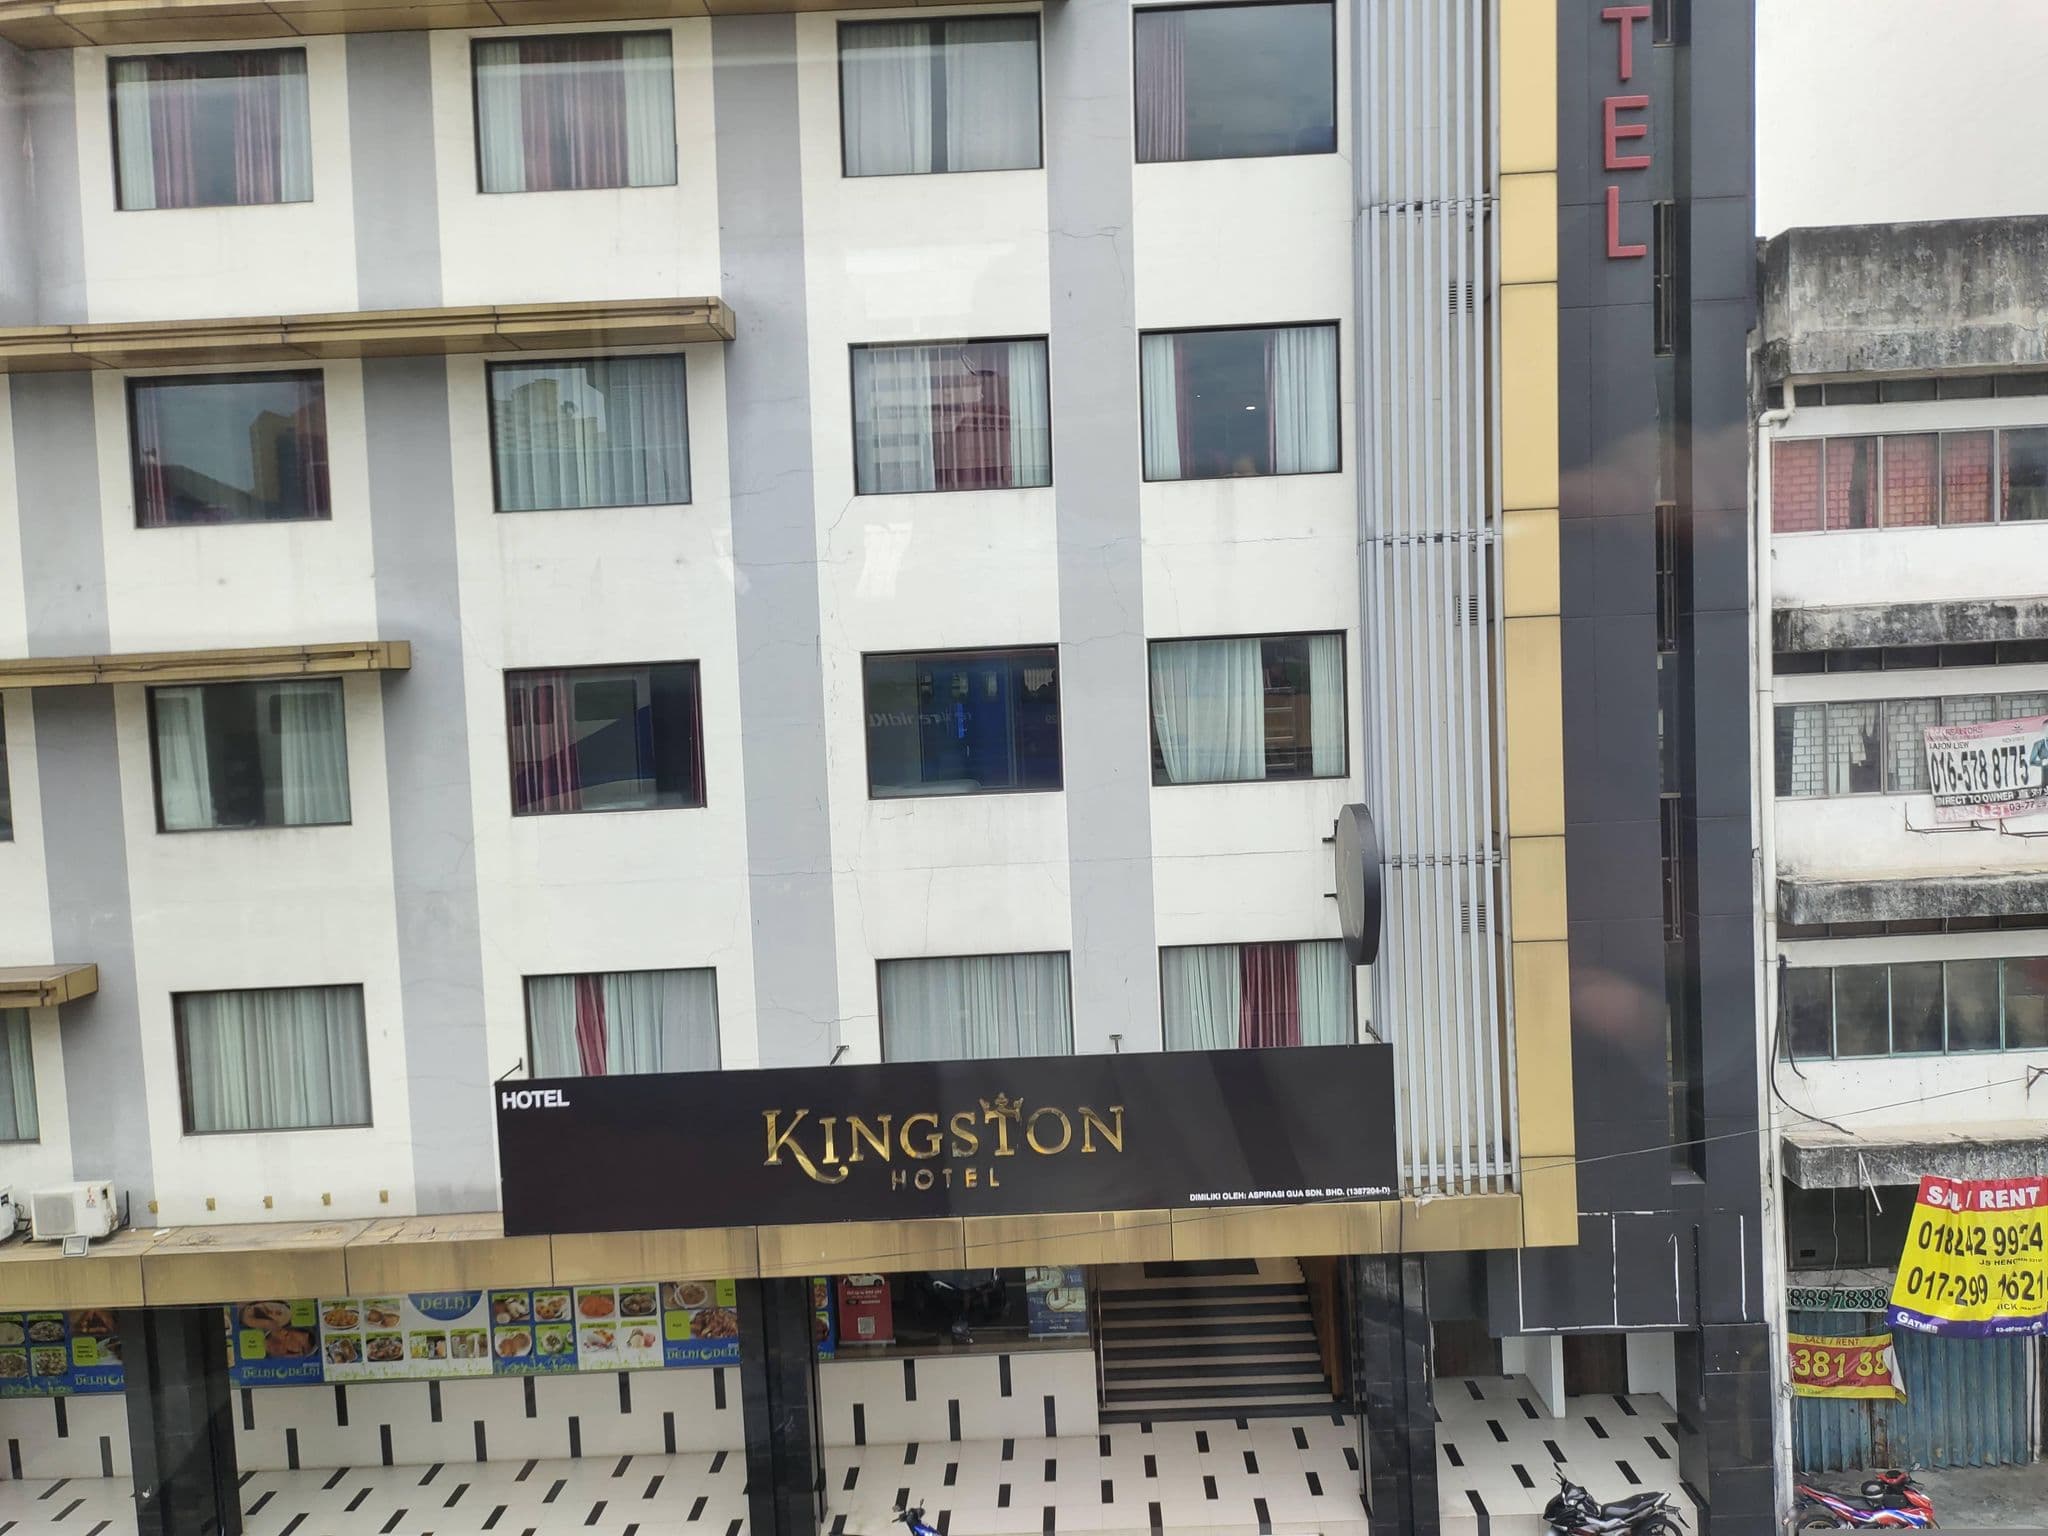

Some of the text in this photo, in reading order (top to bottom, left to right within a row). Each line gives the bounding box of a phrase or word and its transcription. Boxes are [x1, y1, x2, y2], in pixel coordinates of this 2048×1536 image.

[1931, 745, 2030, 794] 016-578 8775
[1936, 795, 1968, 806] DIRECT
[1969, 794, 1982, 804] TO
[1982, 791, 2015, 803] OWNER
[502, 1089, 570, 1110] HOTEL
[762, 1103, 1125, 1185] KINGSTON
[891, 1167, 1001, 1191] HOTEL
[1190, 1193, 1221, 1202] DIMILIKI
[1222, 1192, 1247, 1201] OLEH:
[1248, 1190, 1285, 1200] ASPIRASI
[1305, 1188, 1324, 1198] SDN.
[1325, 1187, 1345, 1197] BHD.
[1979, 1186, 2040, 1209] RENT
[1907, 1266, 2044, 1307] 017-299 1621
[1805, 1336, 1826, 1345] SALE
[1836, 1337, 1860, 1346] RENT
[1794, 1349, 1847, 1379] 381
